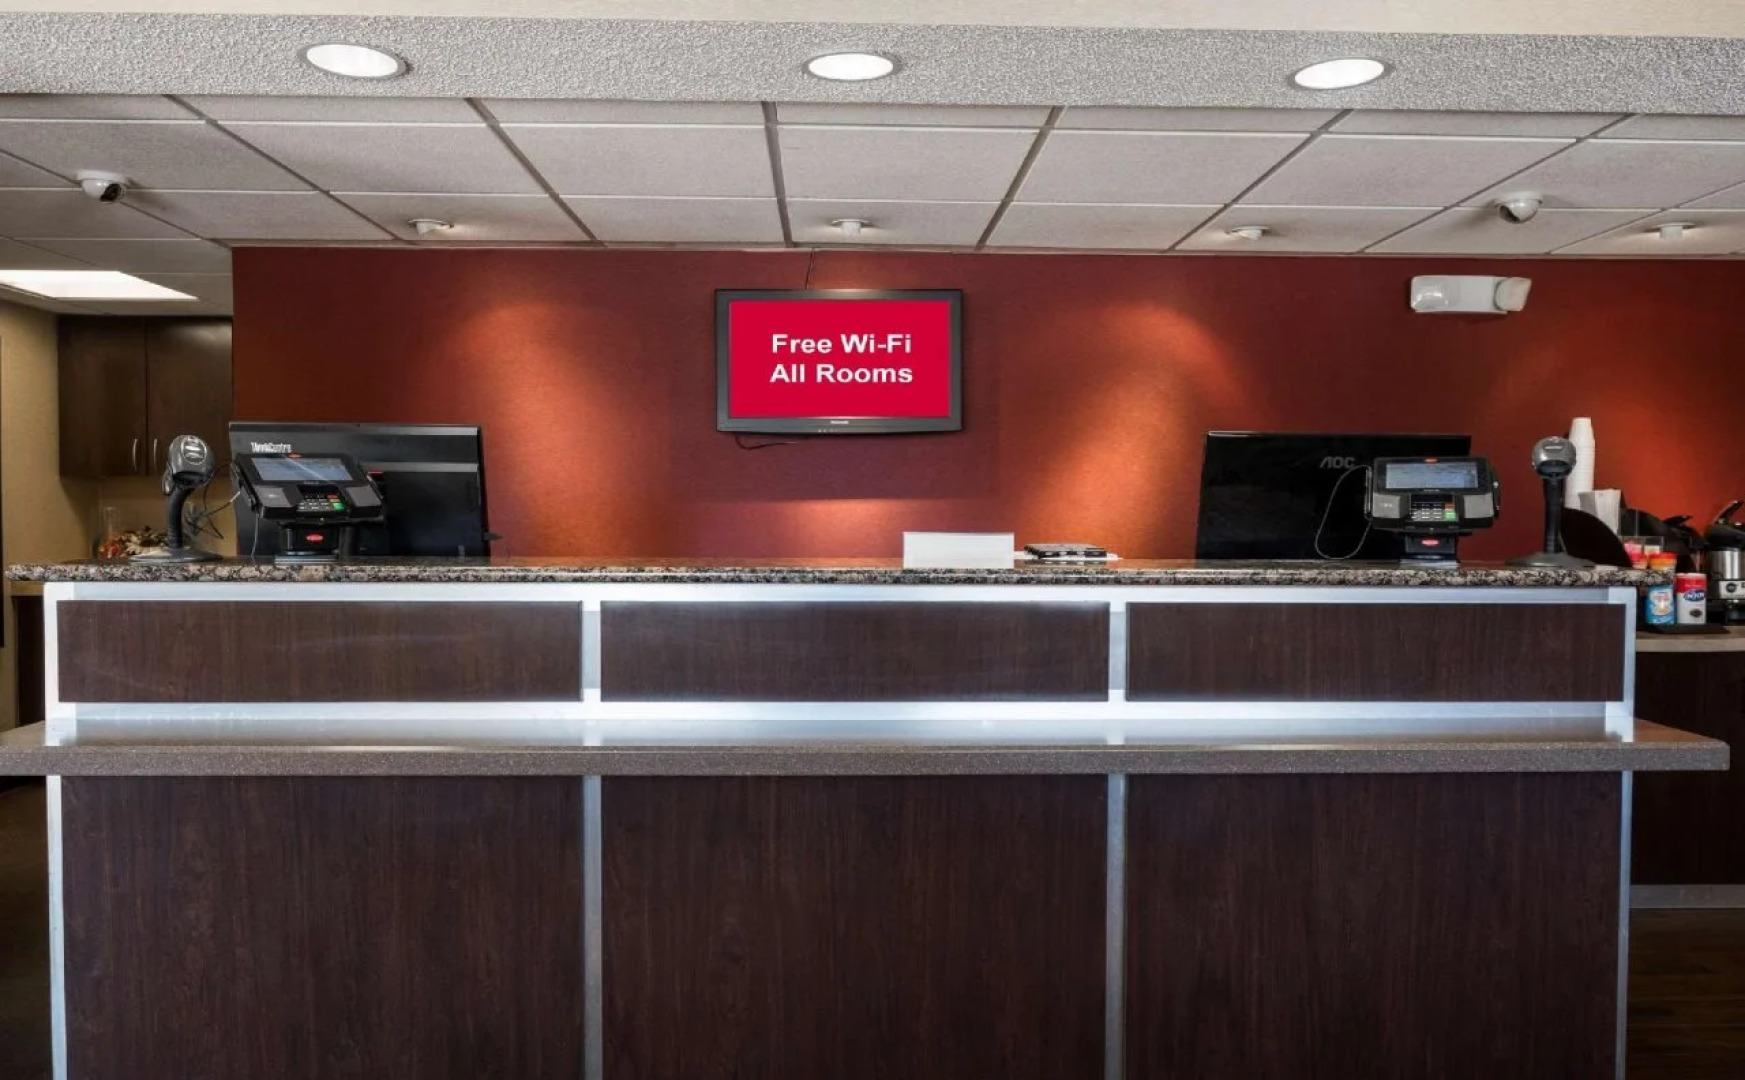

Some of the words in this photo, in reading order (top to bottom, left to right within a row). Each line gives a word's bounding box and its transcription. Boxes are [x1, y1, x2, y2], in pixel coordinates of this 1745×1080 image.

[772, 333, 832, 353] Free
[840, 333, 912, 353] Wi-Fi
[769, 363, 806, 383] All
[816, 363, 913, 383] Rooms
[1320, 456, 1355, 469] AOC
